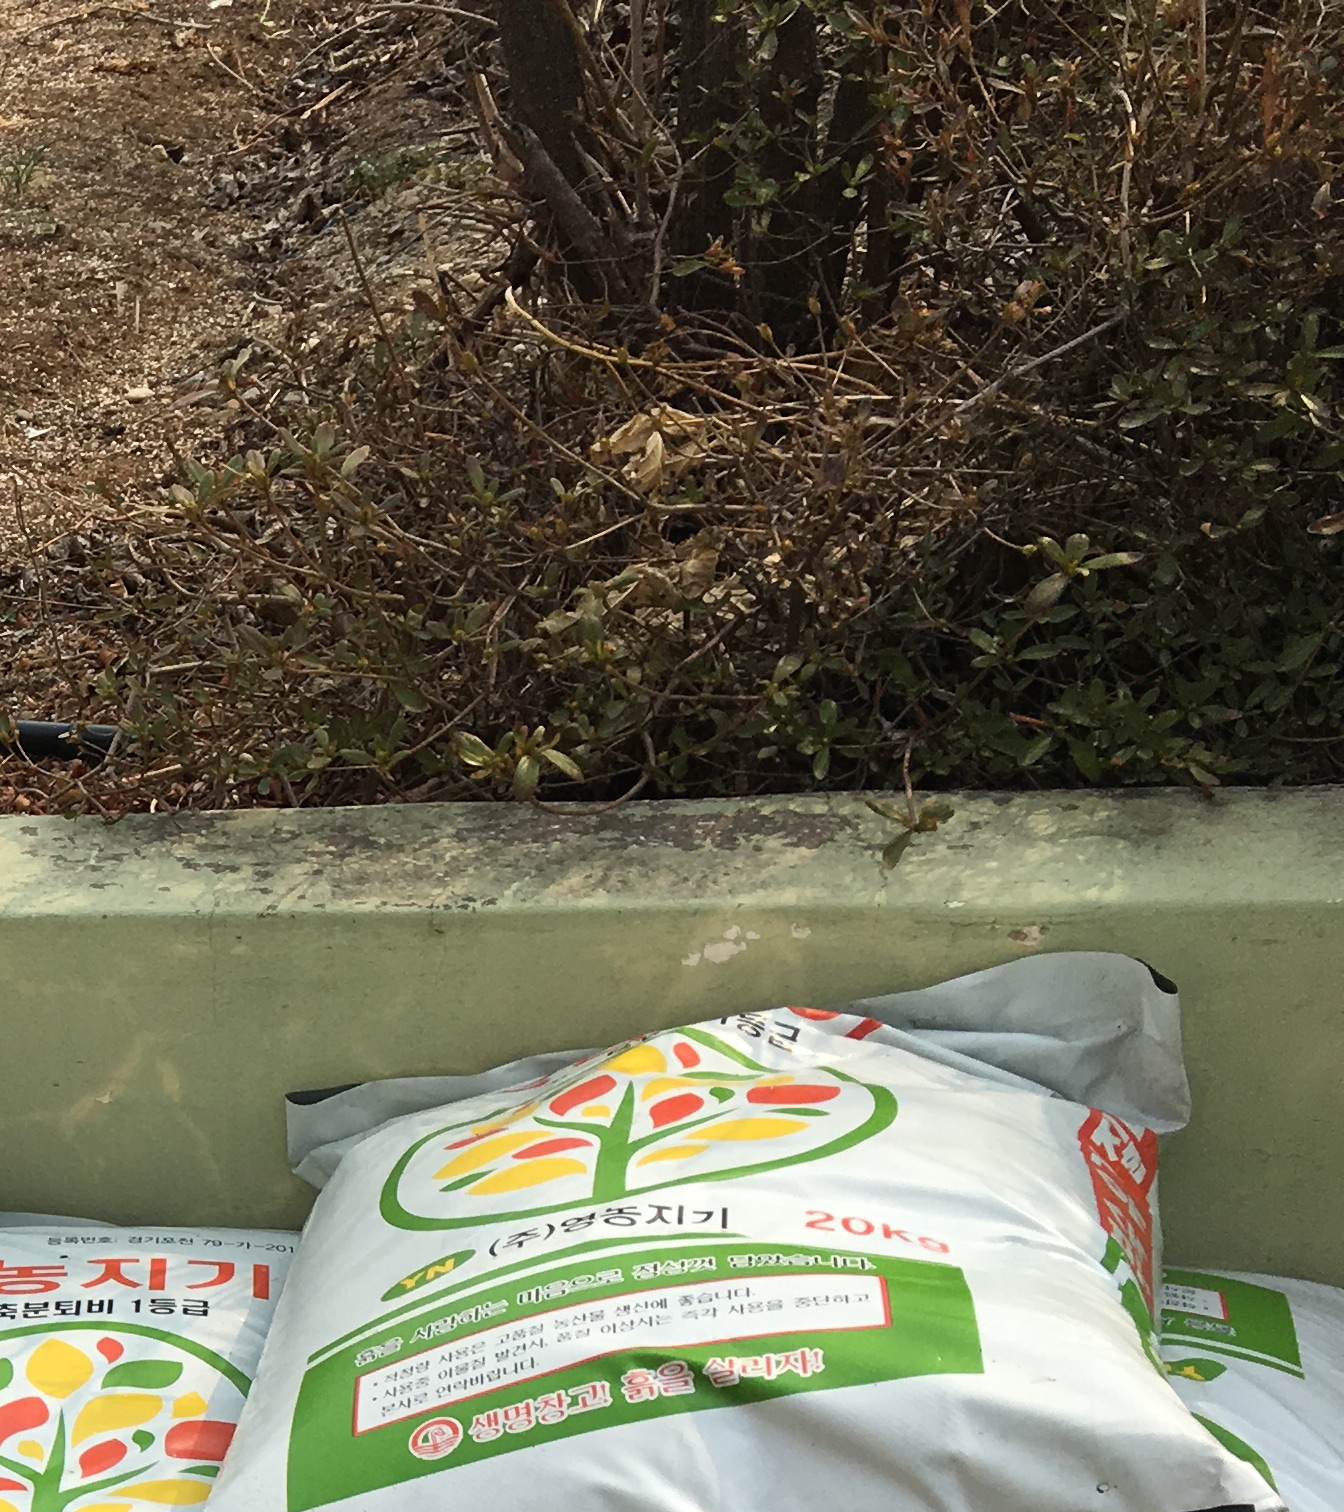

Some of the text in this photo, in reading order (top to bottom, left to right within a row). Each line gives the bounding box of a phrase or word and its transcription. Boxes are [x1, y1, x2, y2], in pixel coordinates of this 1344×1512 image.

[202, 1237, 295, 1254] 79-가-201
[488, 1205, 730, 1258] (주)영농지기
[399, 1257, 457, 1291] YN
[131, 1298, 210, 1318] 1등급
[411, 1299, 509, 1344] 사랑하는
[517, 1269, 624, 1306] 마음으로
[469, 1347, 825, 1441] 생명창고! 흙을 살리자!
